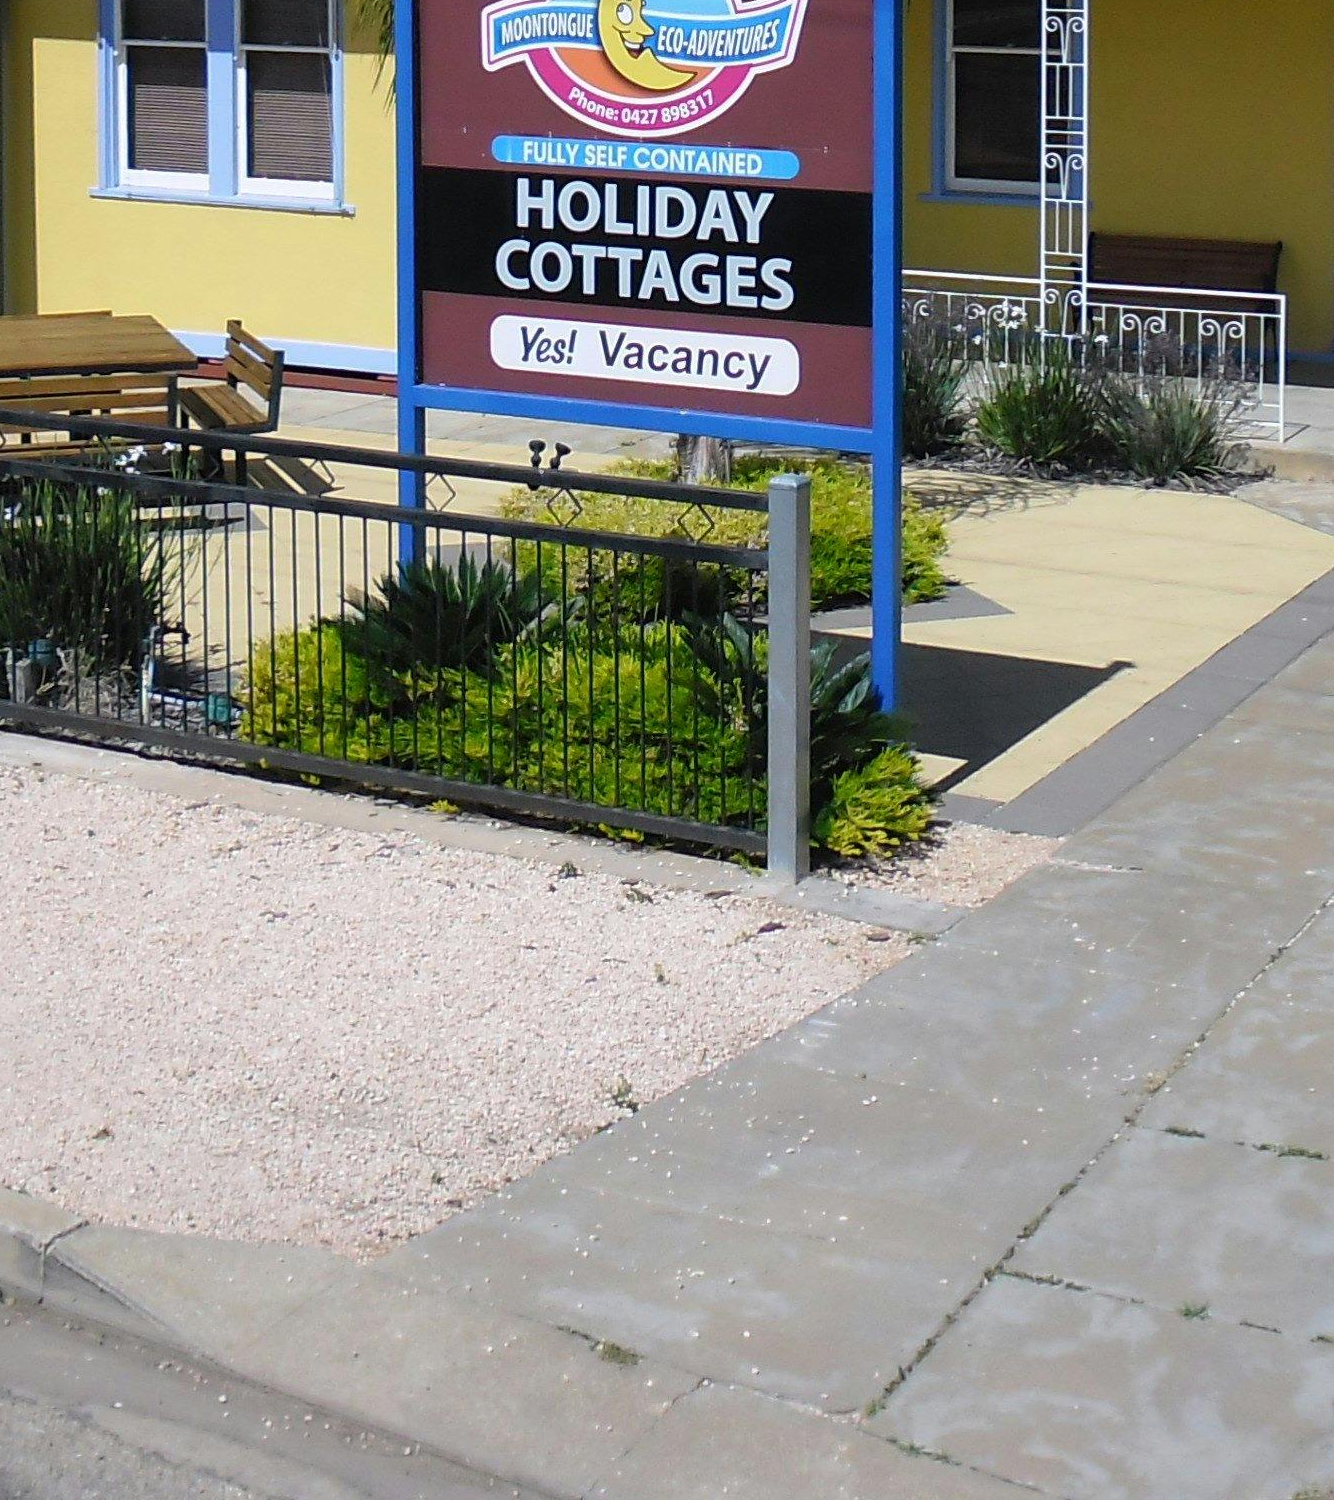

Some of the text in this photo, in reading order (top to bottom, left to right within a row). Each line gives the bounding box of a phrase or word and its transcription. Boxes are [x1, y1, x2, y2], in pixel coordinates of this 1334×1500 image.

[500, 13, 780, 58] MOONTONGUE ECO-ADVENTURES
[569, 86, 714, 125] Phone: 0427 898317
[523, 141, 763, 176] FULLY SELF CONTAINED
[516, 176, 774, 245] HOLIDAY
[495, 238, 794, 311] COTTAGES
[519, 325, 772, 390] Yes! Vacancy
